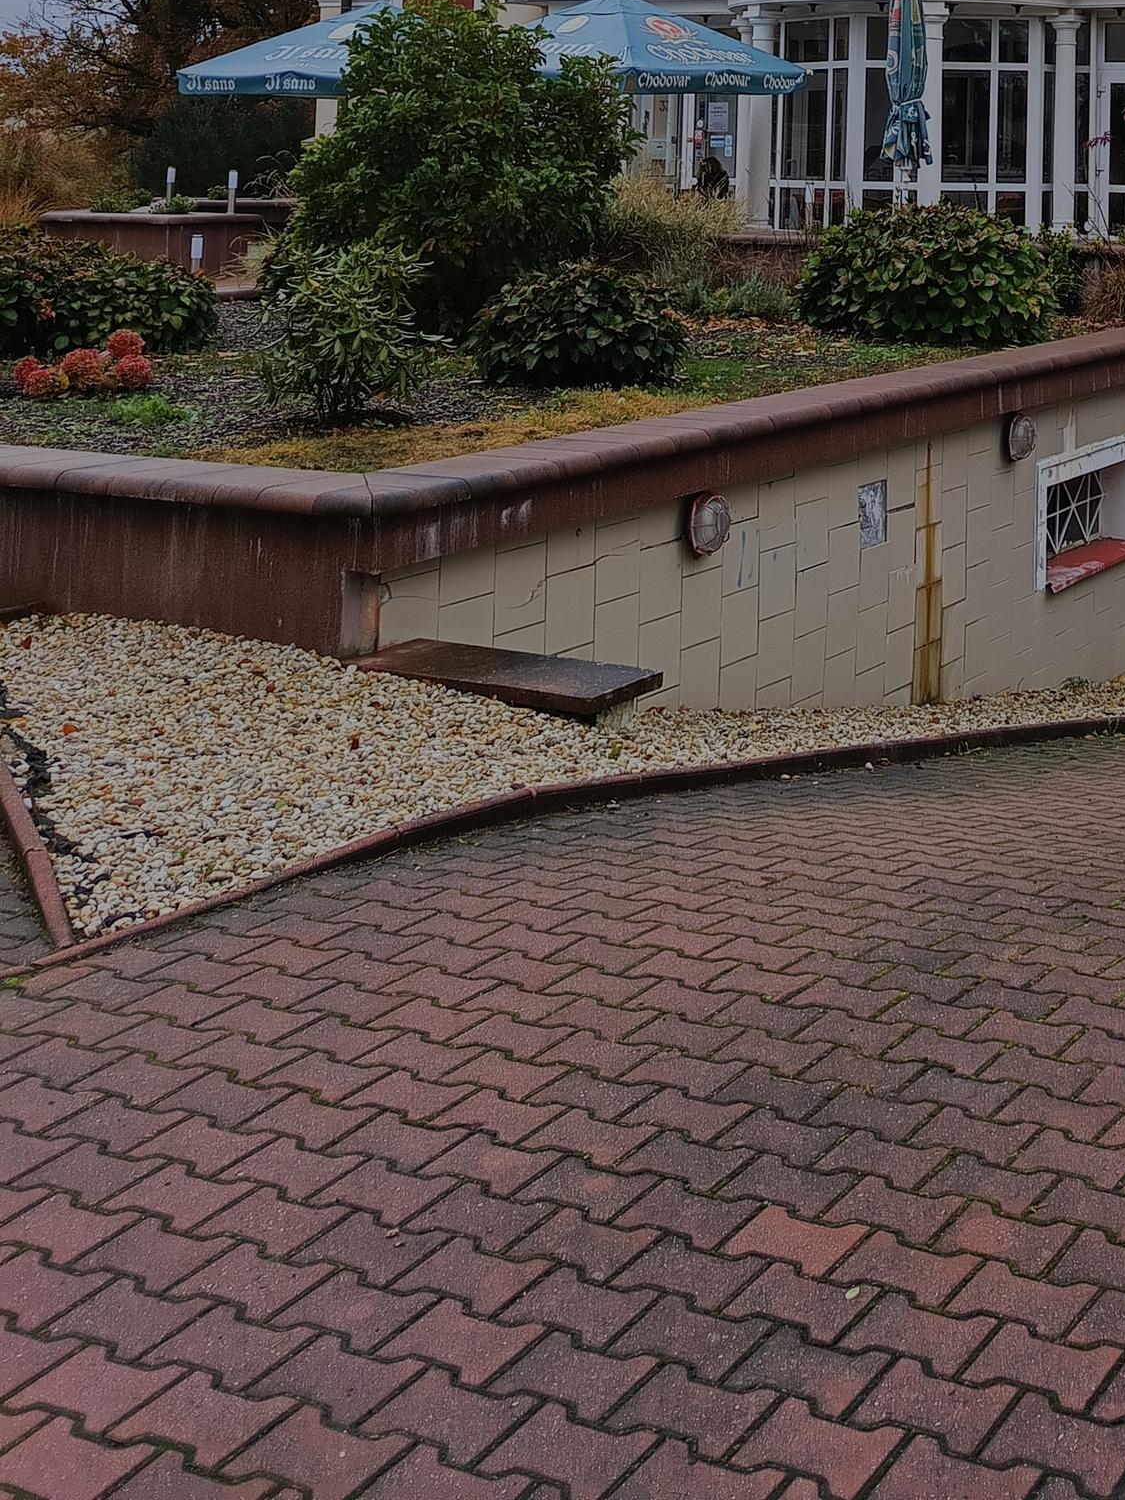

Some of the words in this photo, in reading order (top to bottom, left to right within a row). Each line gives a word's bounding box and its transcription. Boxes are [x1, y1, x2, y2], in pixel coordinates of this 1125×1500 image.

[204, 78, 236, 91] sano
[283, 78, 316, 91] sano
[637, 71, 691, 89] Chodovar
[704, 71, 750, 88] Chodovar
